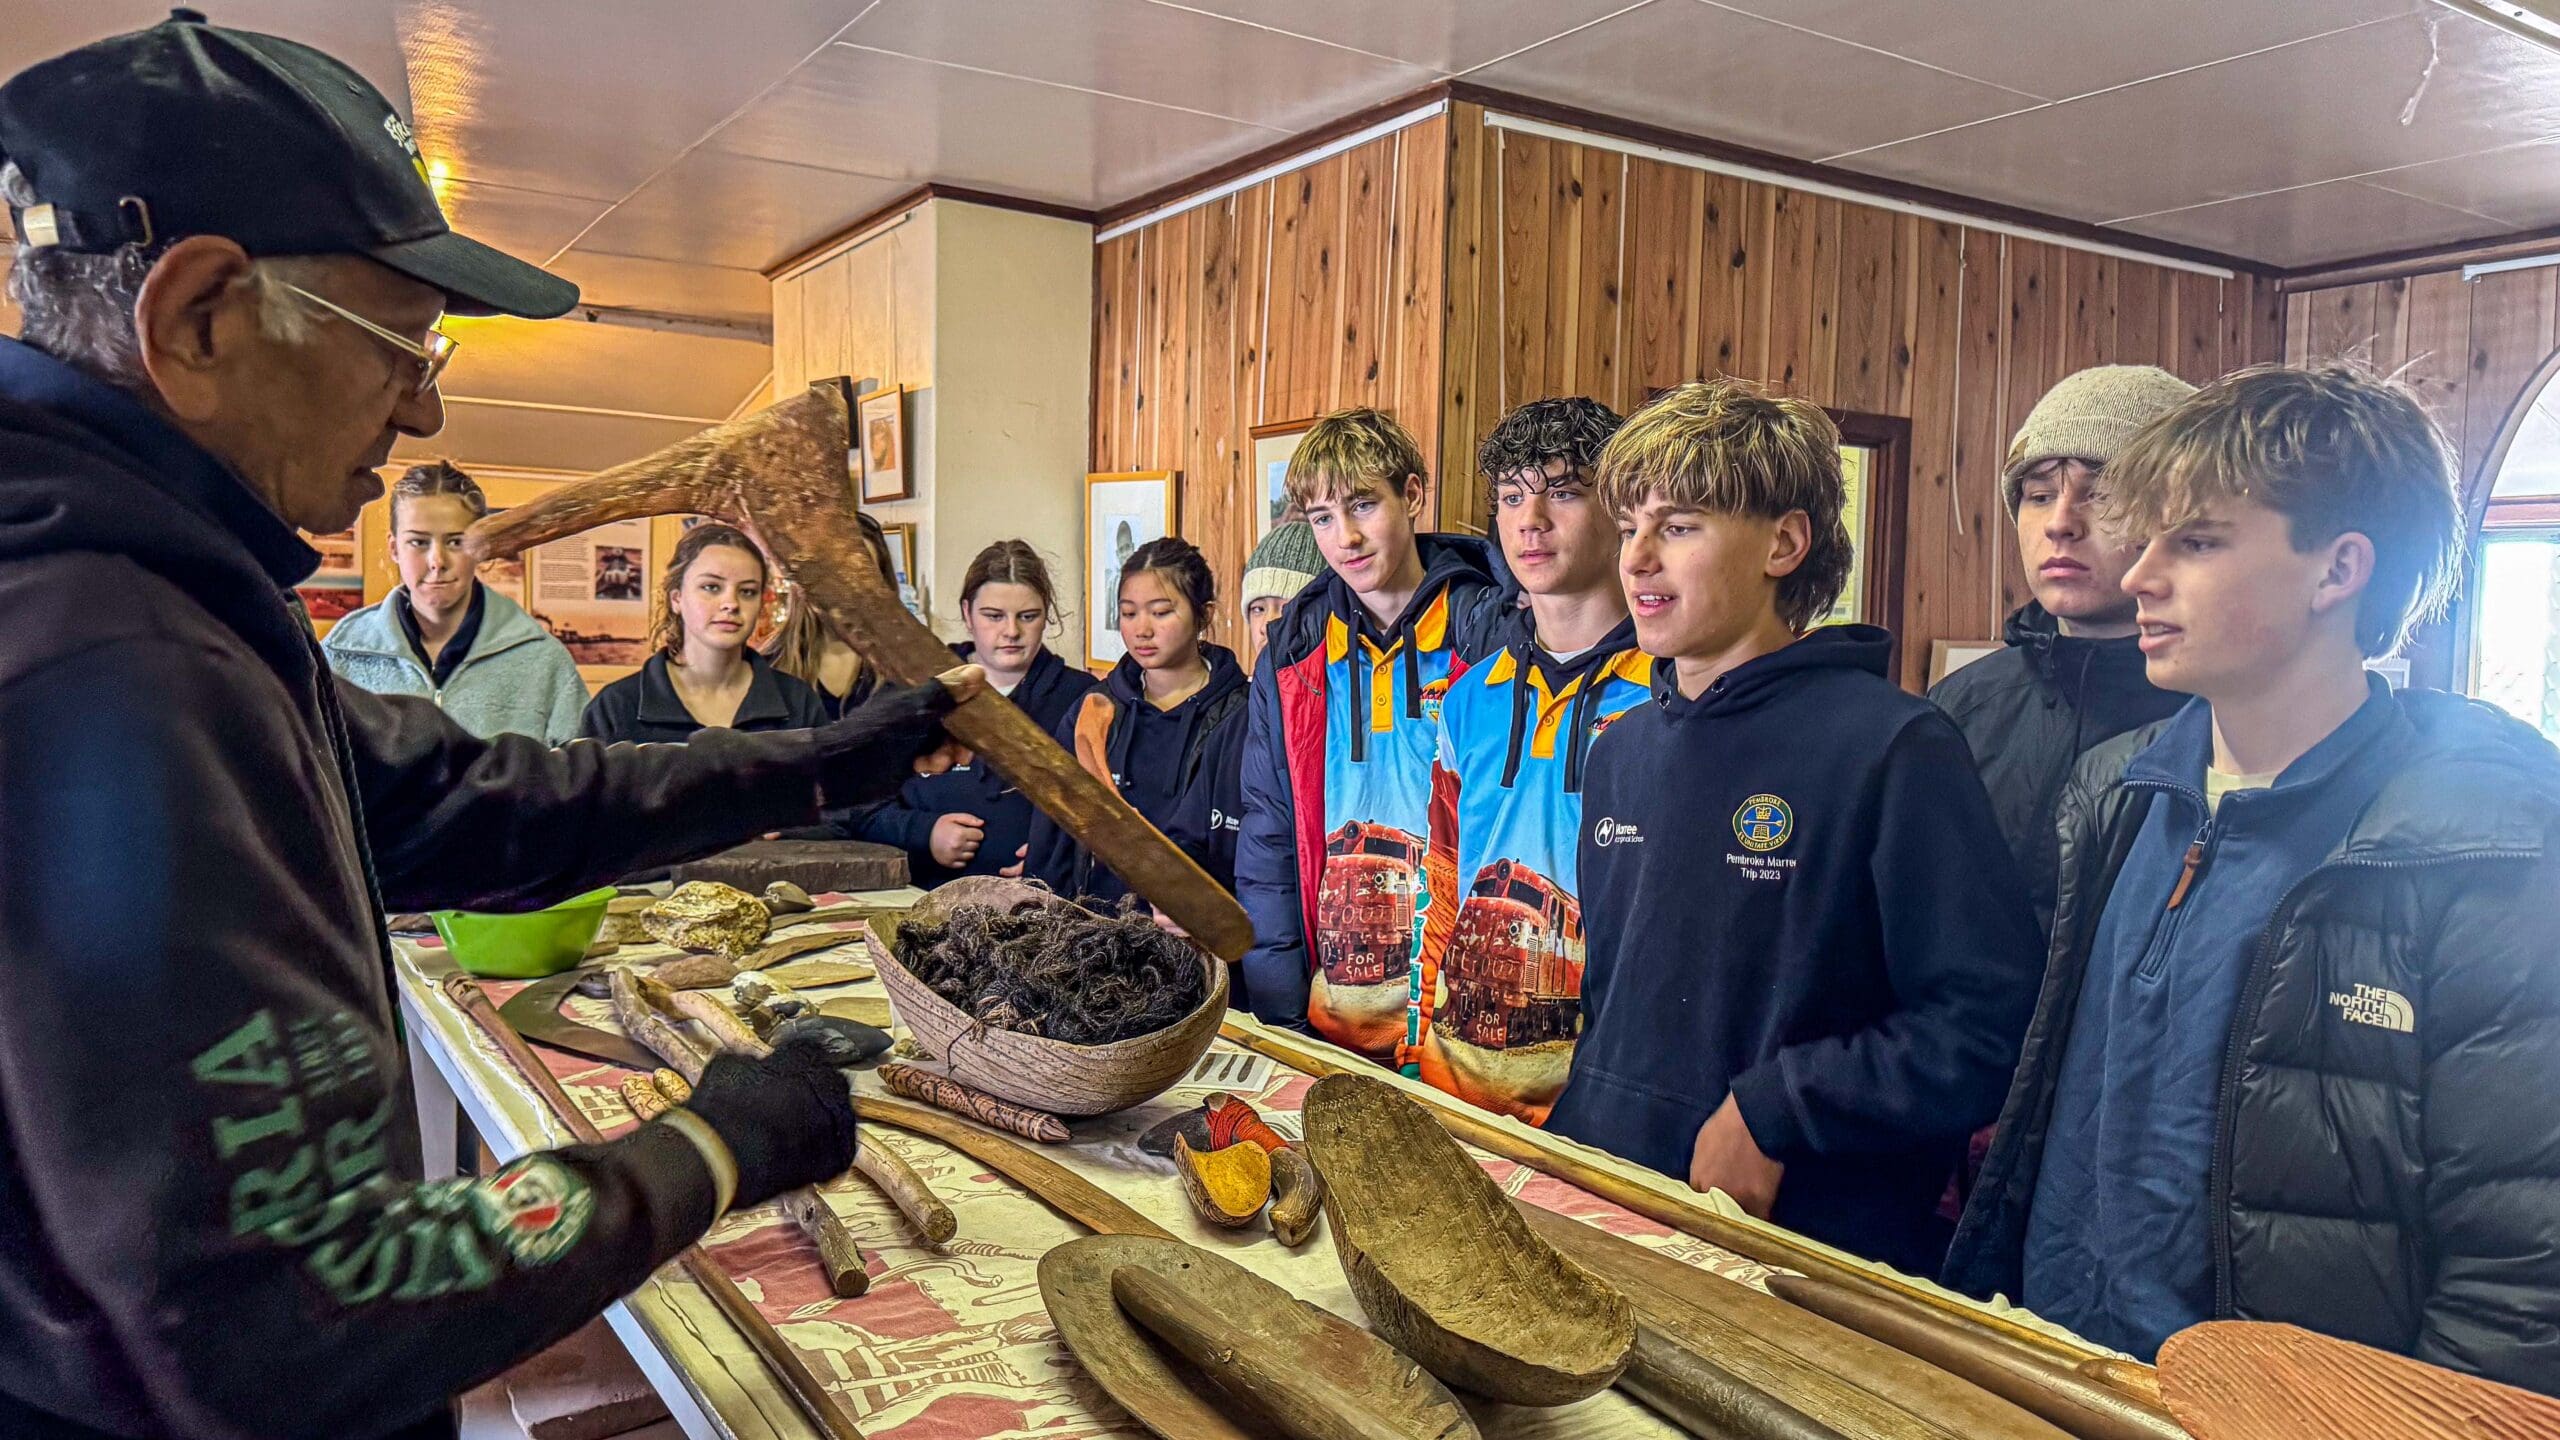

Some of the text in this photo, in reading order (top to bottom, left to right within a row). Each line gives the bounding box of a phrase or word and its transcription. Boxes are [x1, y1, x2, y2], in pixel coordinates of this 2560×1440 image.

[1726, 853, 1765, 866] Pembroke
[1741, 867, 1781, 881] Trip 2023
[1347, 953, 1376, 966] FOR
[1345, 963, 1383, 980] SALE
[2354, 983, 2386, 1001] THE
[2329, 991, 2385, 1014] NORTH
[1479, 1011, 1501, 1025] FOR
[2342, 1007, 2385, 1027] FACE
[1476, 1024, 1504, 1041] SALE
